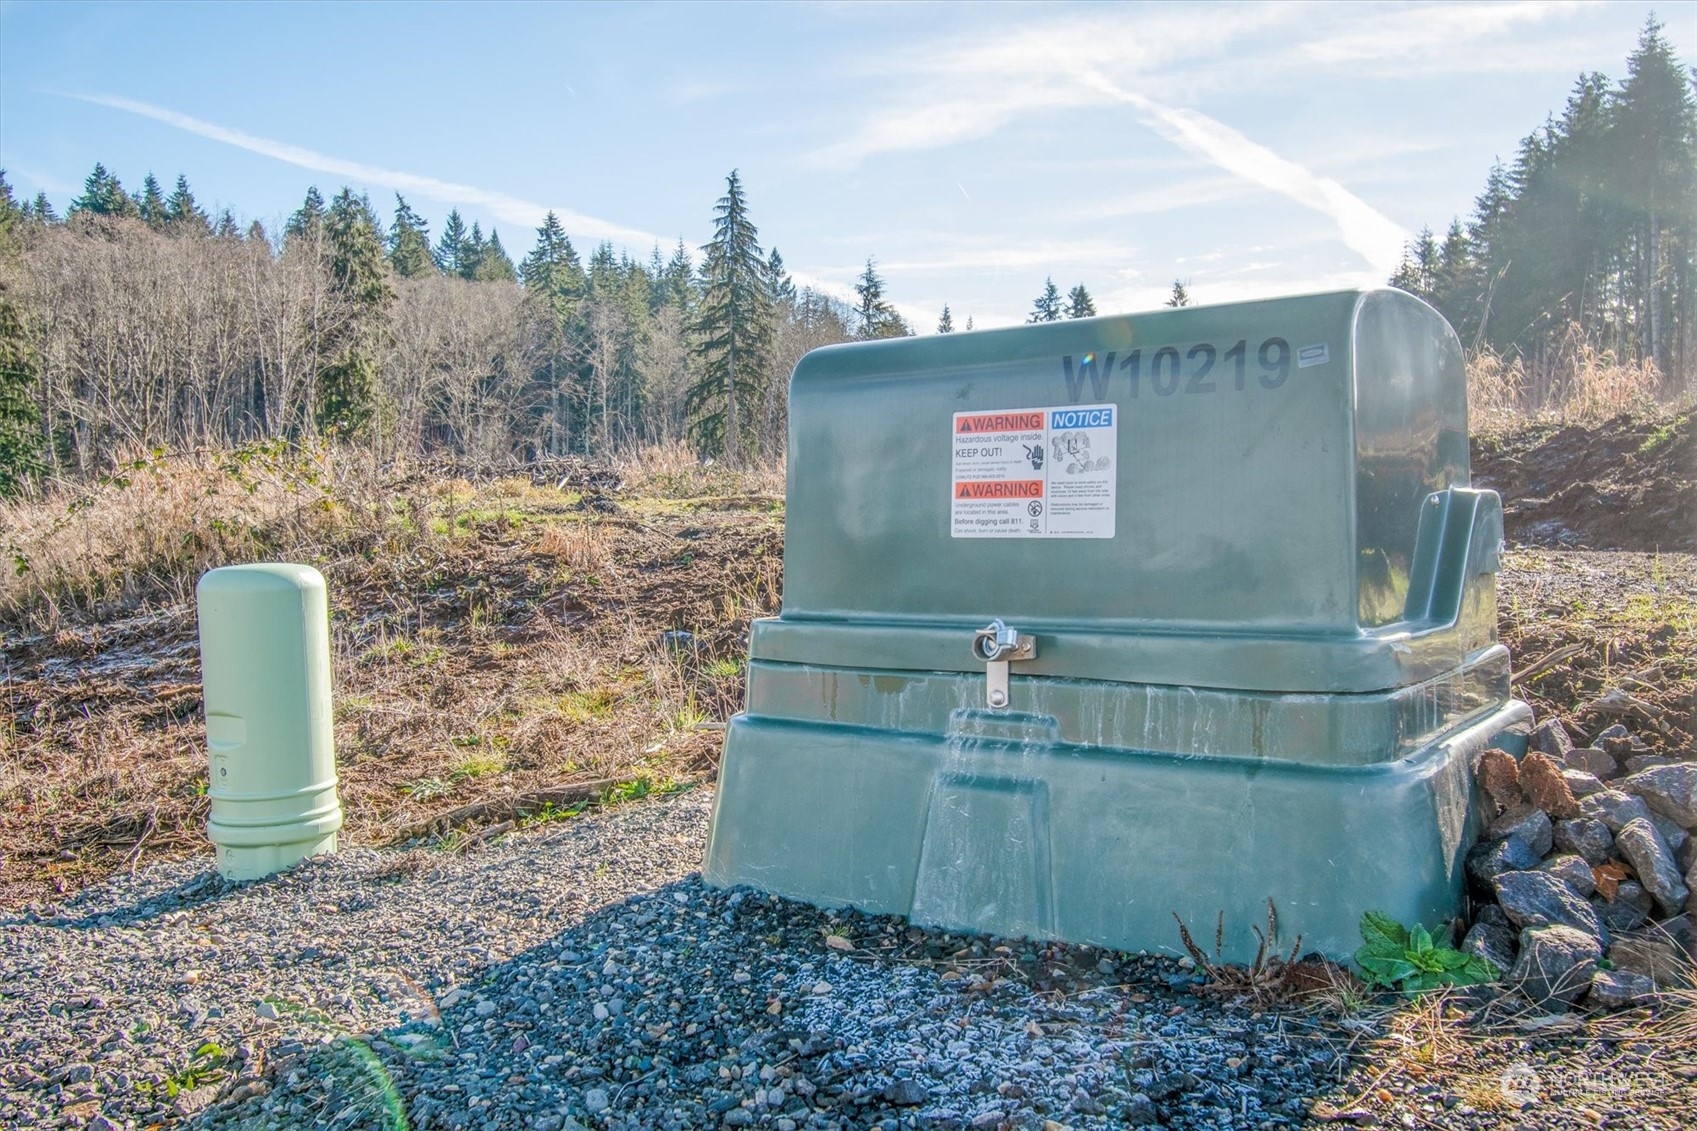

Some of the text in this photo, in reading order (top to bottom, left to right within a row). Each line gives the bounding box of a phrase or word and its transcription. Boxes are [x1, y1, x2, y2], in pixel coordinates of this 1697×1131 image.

[1062, 336, 1291, 401] W10219
[973, 414, 1040, 431] WARNING
[1053, 410, 1111, 428] NOTICE
[955, 435, 992, 444] Hazardous
[994, 434, 1019, 443] voltage
[955, 447, 1003, 458] KEEP OUT!
[972, 481, 1039, 498] WARNING
[975, 517, 998, 526] digging
[998, 517, 1010, 525] call
